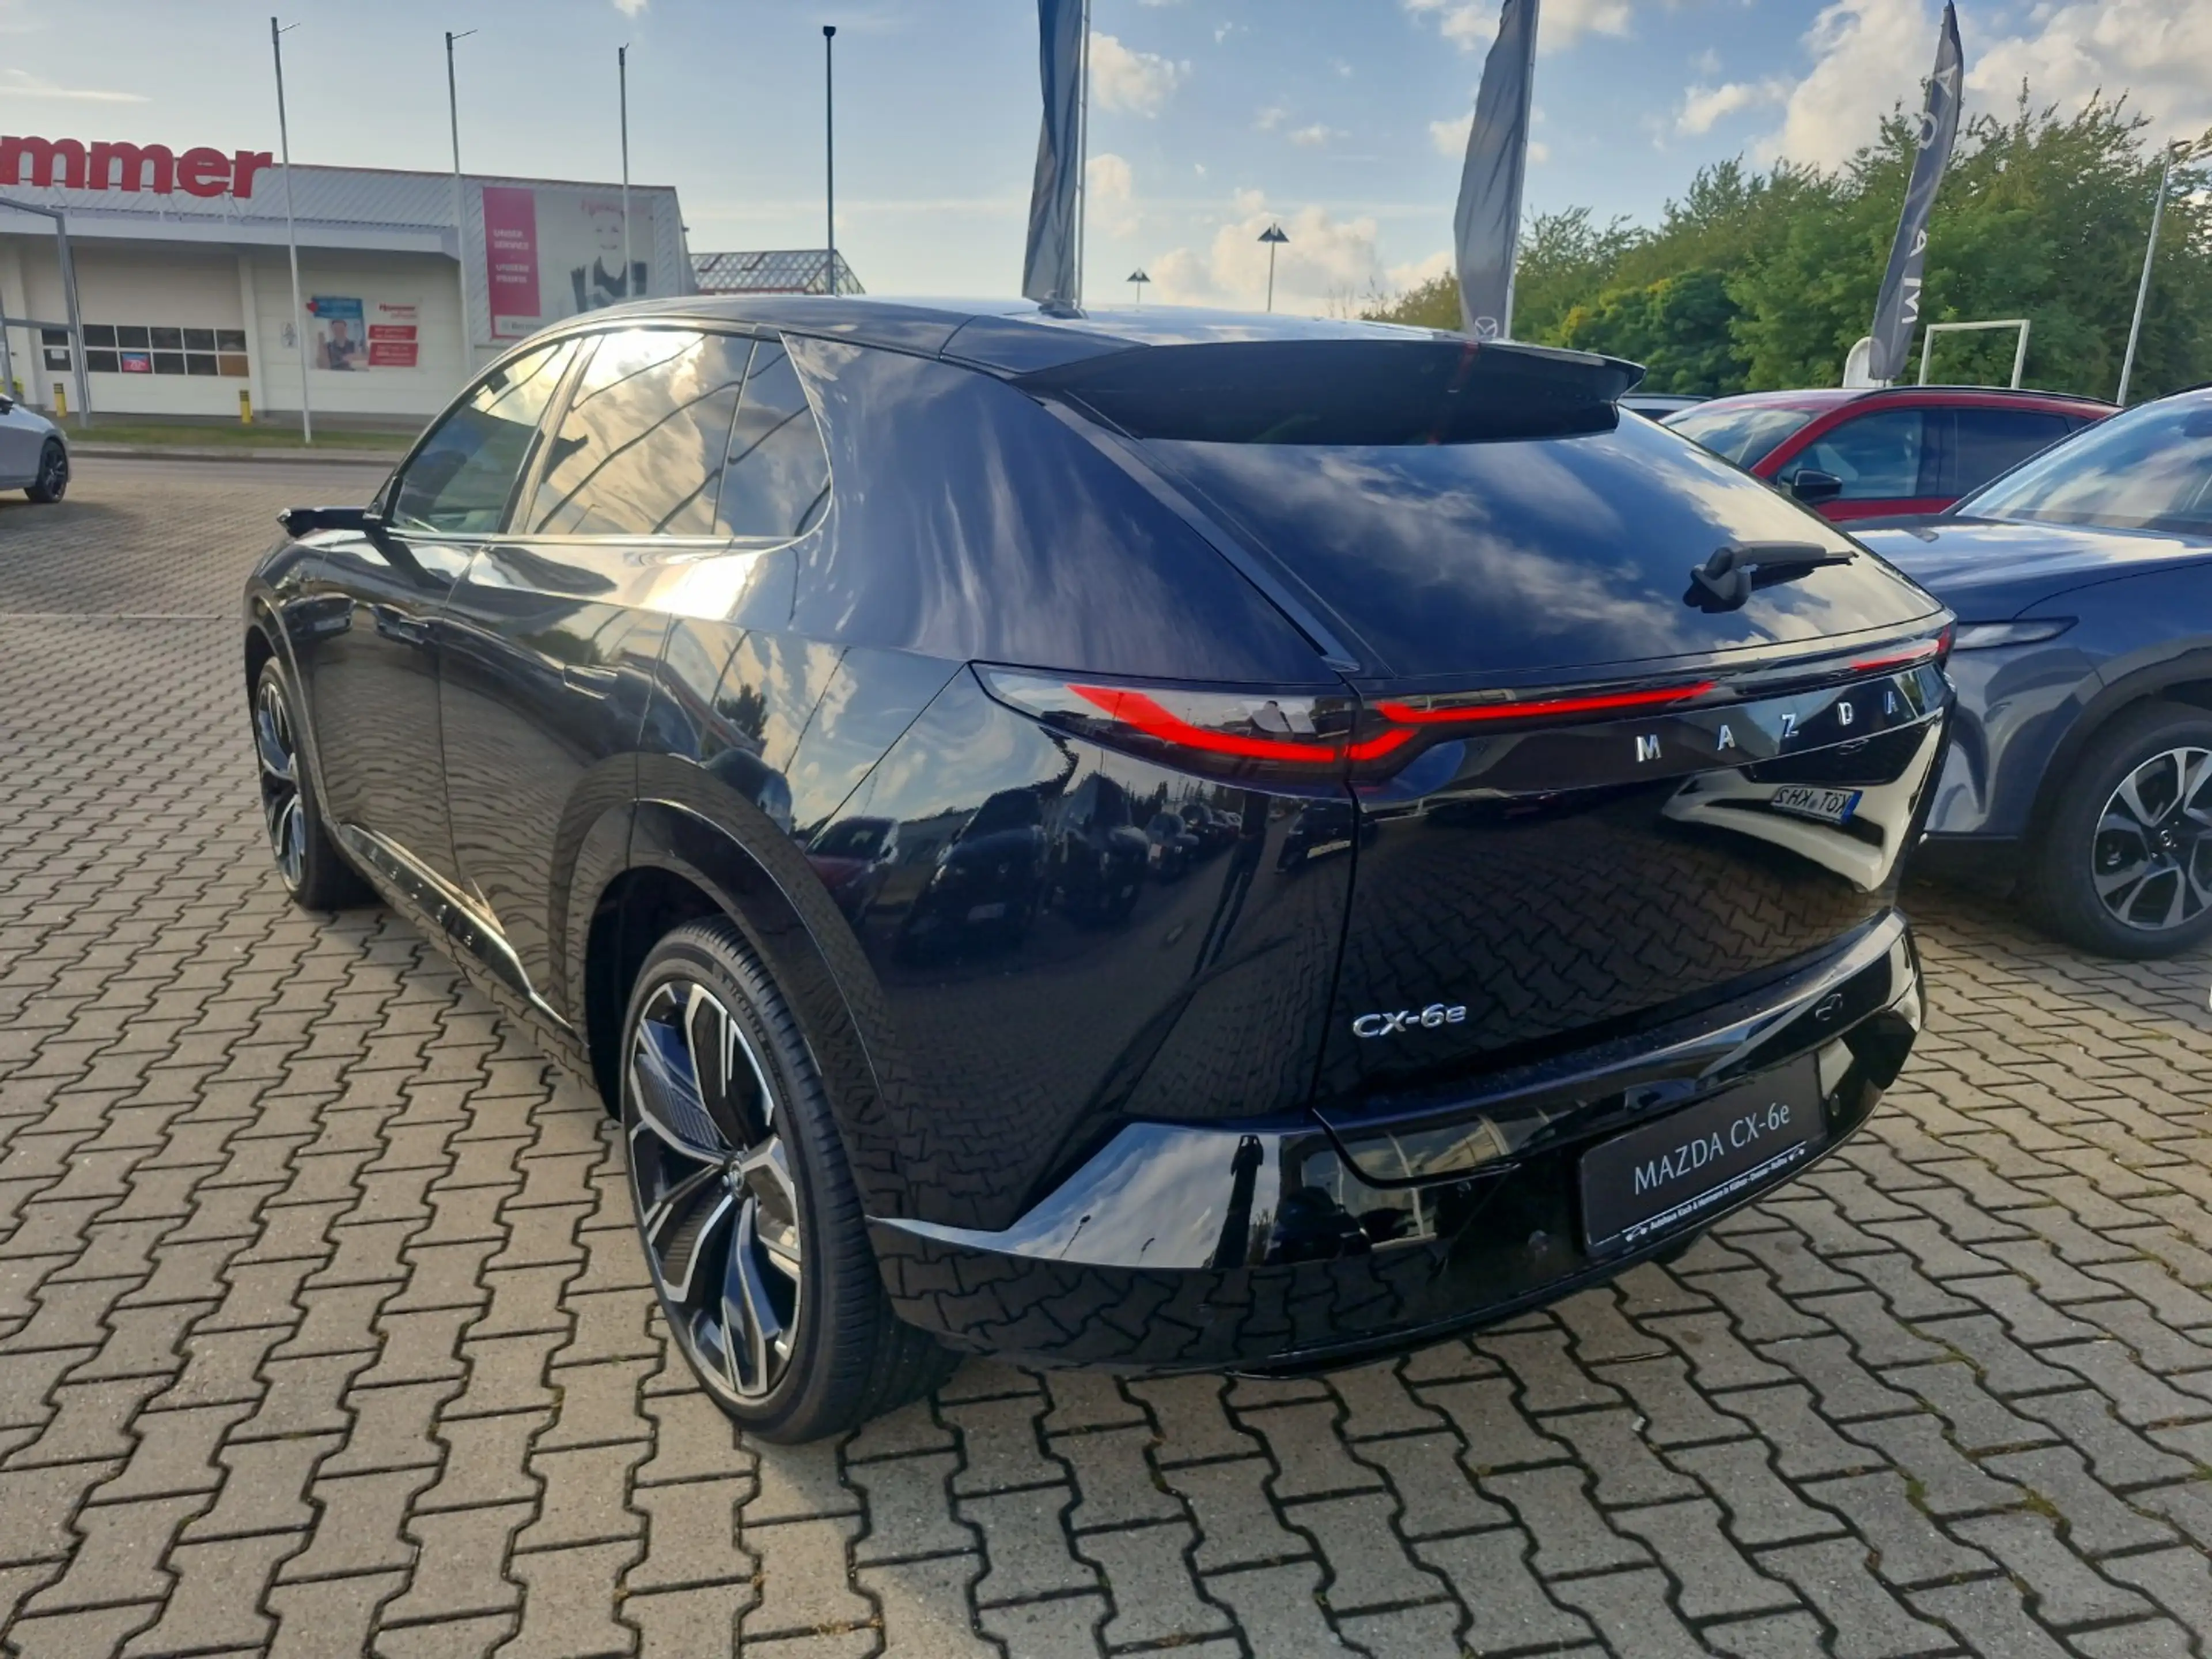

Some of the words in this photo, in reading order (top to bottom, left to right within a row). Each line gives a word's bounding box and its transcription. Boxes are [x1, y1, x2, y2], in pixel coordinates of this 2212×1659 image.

[0, 136, 272, 198] mmer
[1635, 691, 1899, 762] MAZDA
[1353, 1003, 1467, 1037] CX-6e
[1635, 1132, 1724, 1195] MAZDA
[1730, 1103, 1790, 1148] CX-6e
